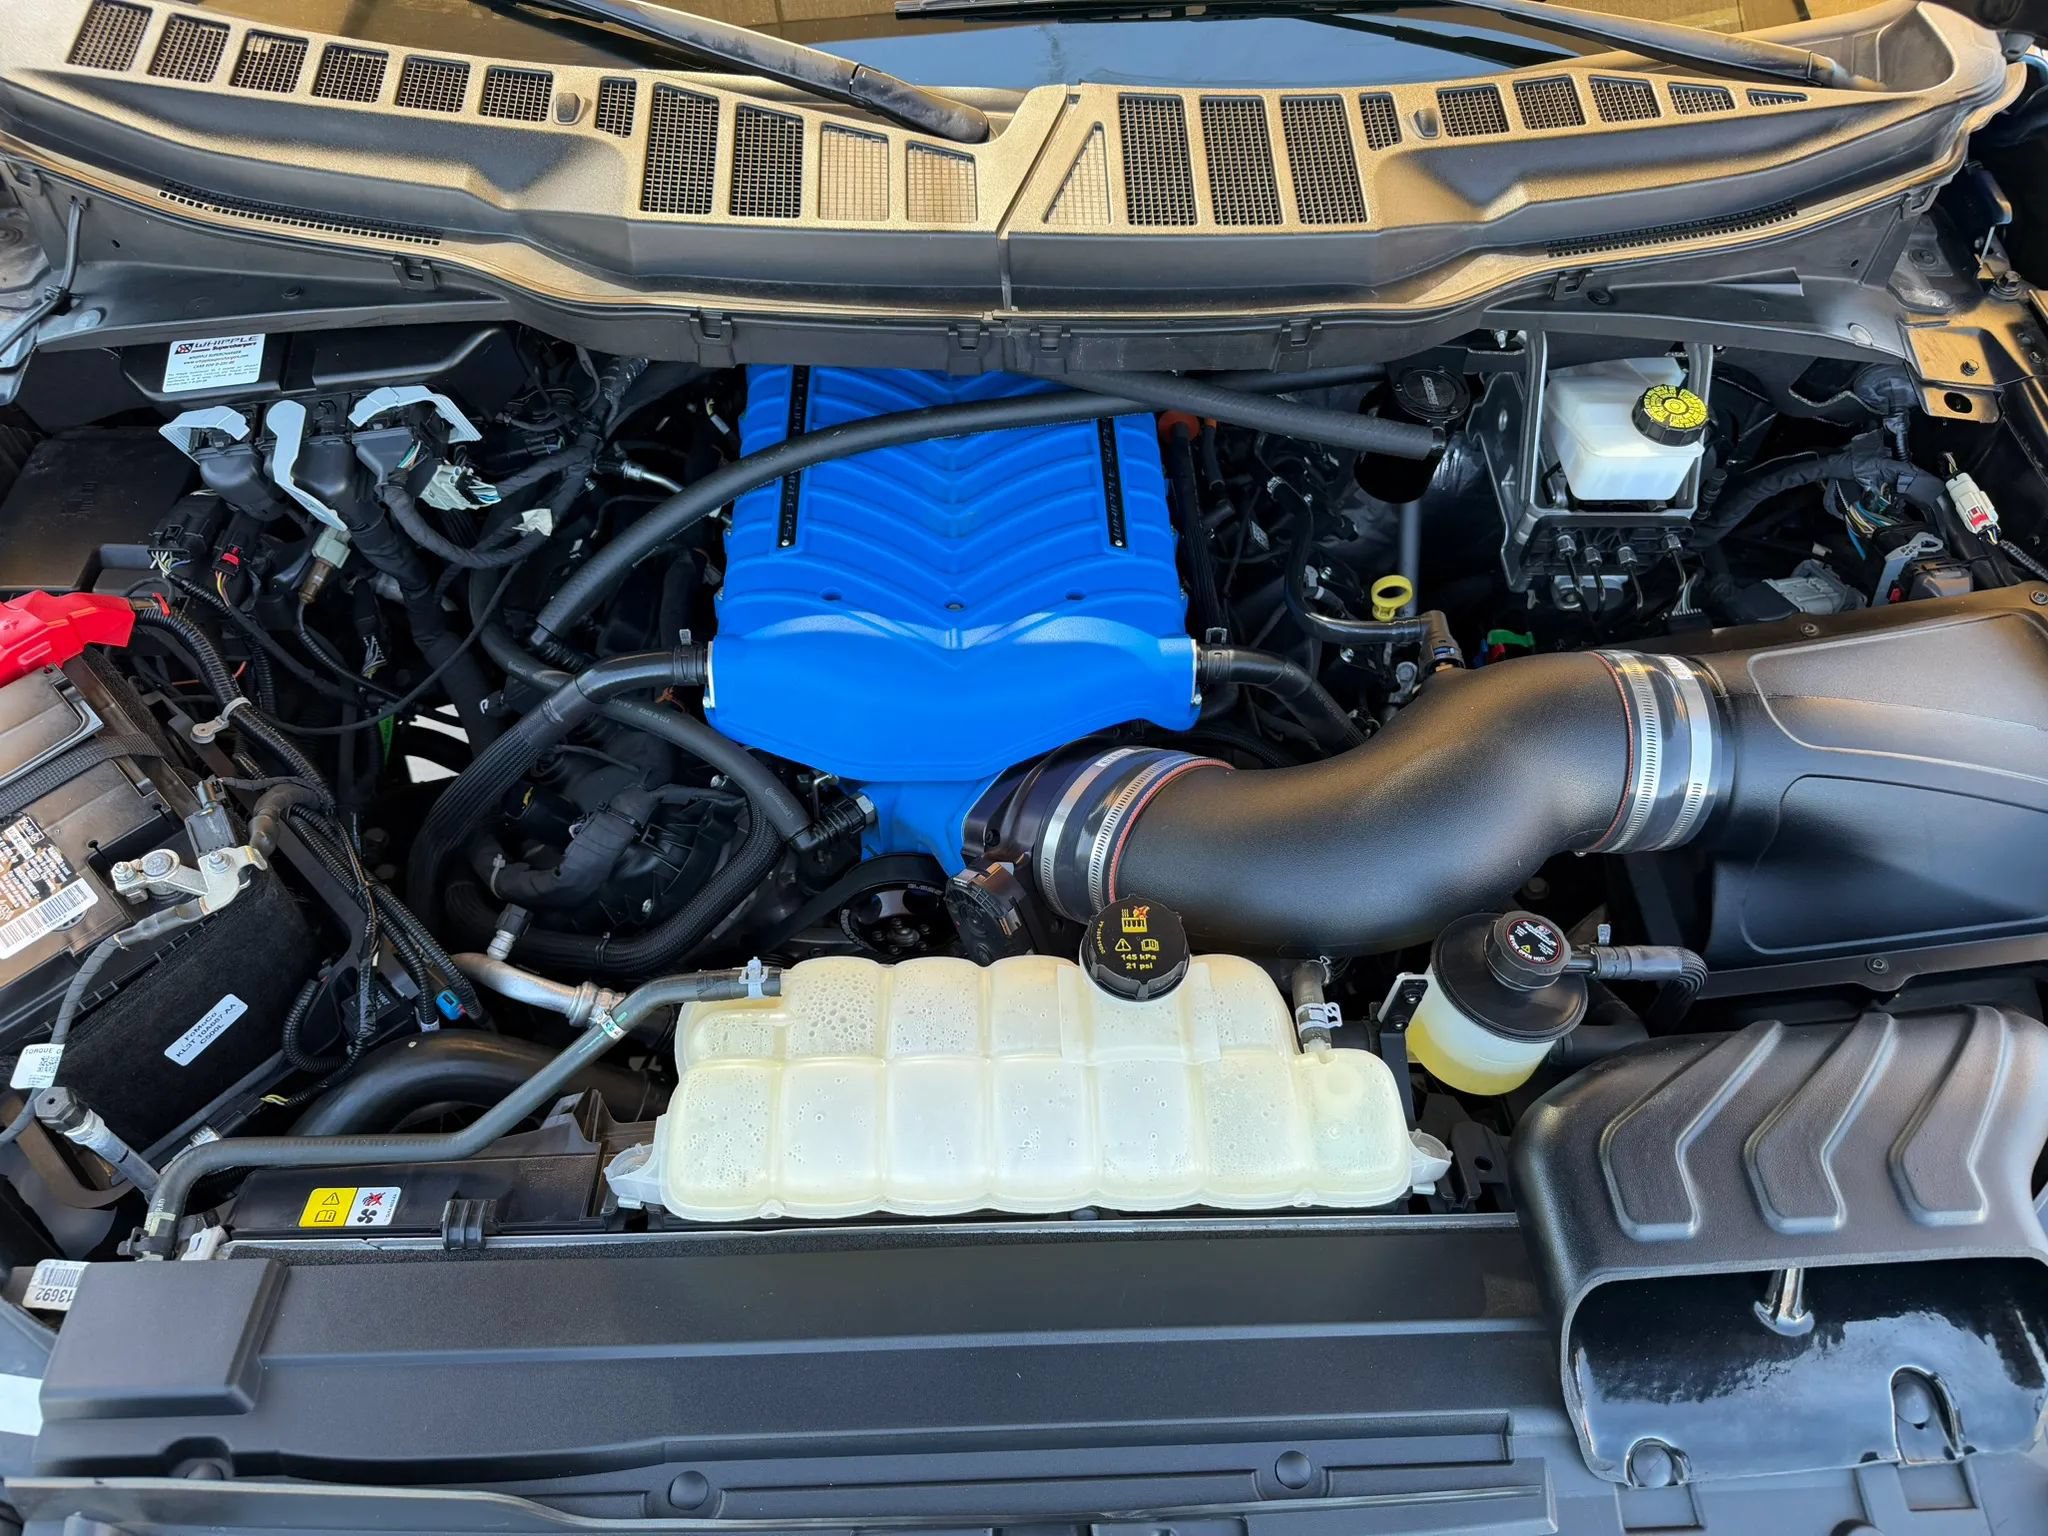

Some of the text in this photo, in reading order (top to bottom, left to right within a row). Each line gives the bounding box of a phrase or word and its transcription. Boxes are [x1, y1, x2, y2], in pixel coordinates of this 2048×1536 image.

[195, 336, 260, 348] WHIPPLE
[1139, 962, 1153, 971] psi
[184, 1012, 217, 1042] FoMoCo
